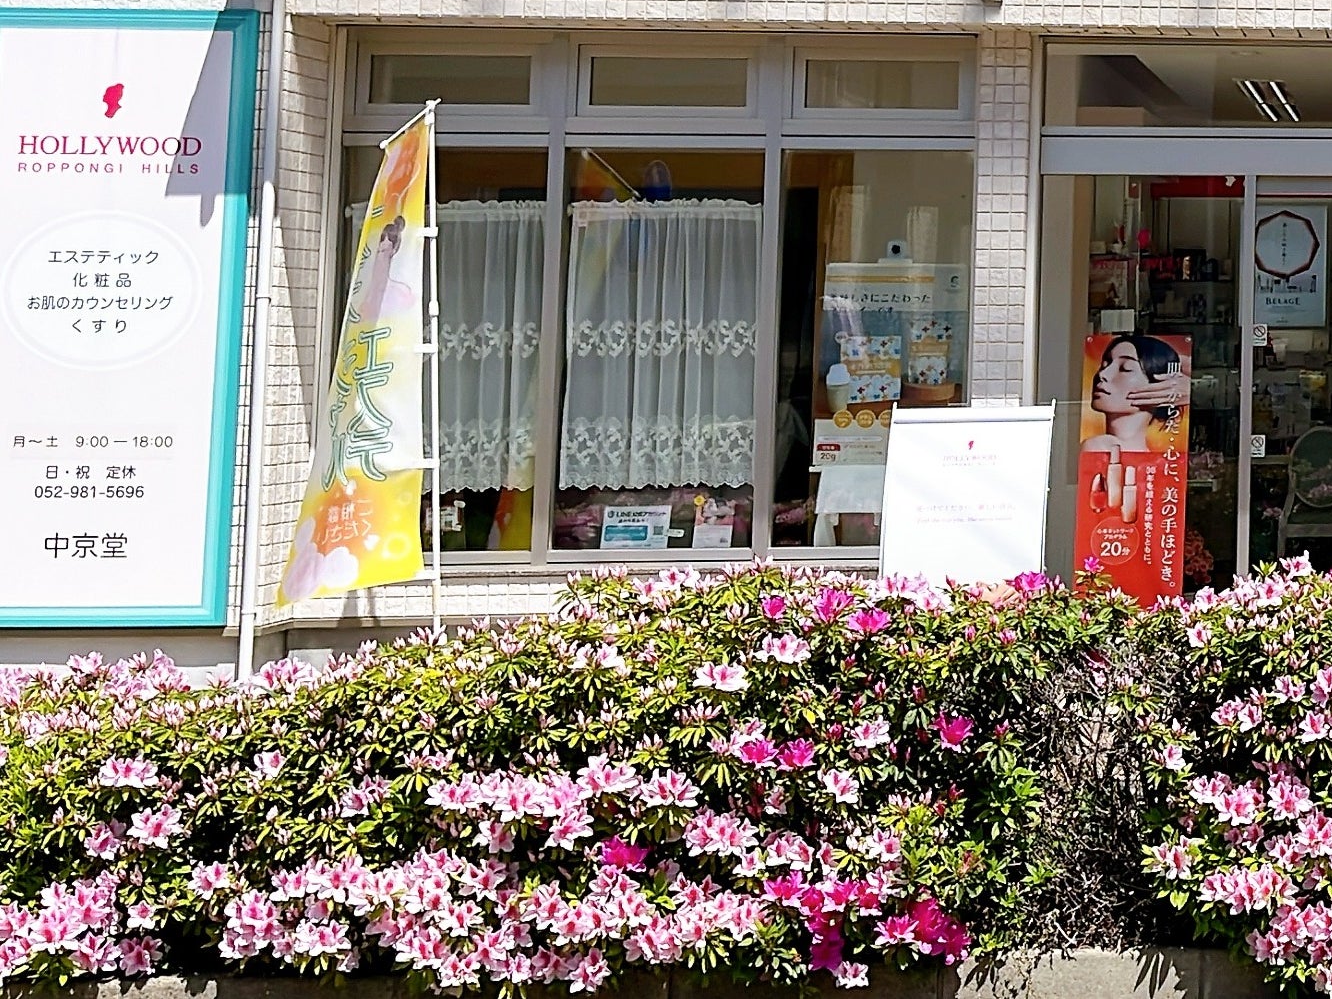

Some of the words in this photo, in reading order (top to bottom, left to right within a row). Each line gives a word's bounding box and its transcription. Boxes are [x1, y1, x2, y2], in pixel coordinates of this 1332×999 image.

[18, 134, 202, 158] HOLLYWOOD
[18, 162, 124, 174] ROPPONGI
[141, 162, 200, 175] HILLS
[48, 248, 160, 264] エステティック
[72, 272, 132, 288] 化粧品
[27, 295, 174, 312] お肌のカウンセリング
[70, 318, 129, 335] くすり
[46, 465, 90, 479] 日・祝
[106, 465, 137, 479] 定休
[34, 486, 144, 498] 052-981-5696
[45, 533, 128, 558] 中京堂
